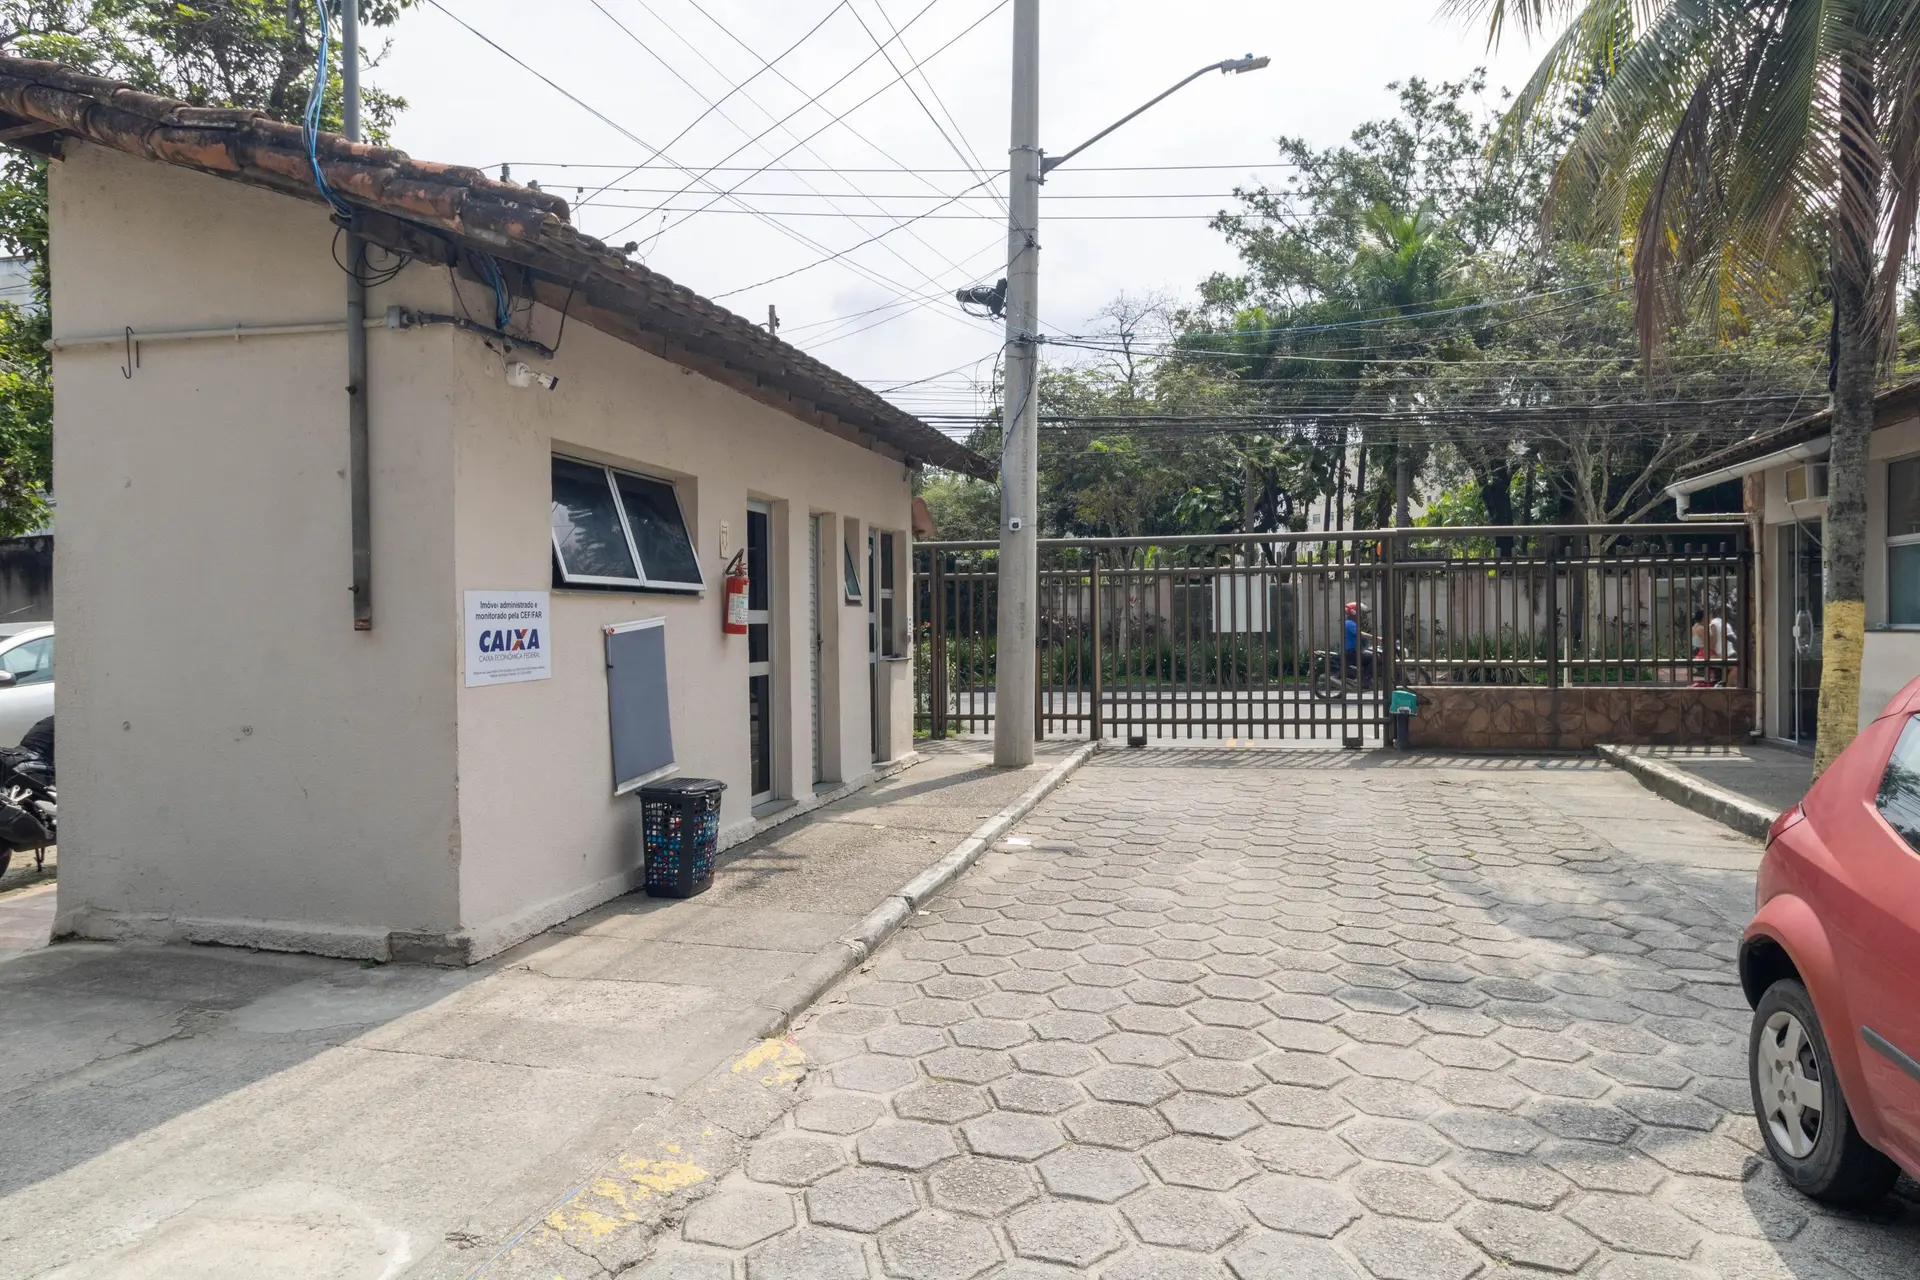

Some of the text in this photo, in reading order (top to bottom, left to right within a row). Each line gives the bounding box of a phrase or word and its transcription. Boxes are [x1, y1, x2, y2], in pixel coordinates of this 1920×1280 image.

[508, 612, 519, 620] pela
[479, 629, 540, 653] CAIXA
[479, 655, 494, 663] CAIXA
